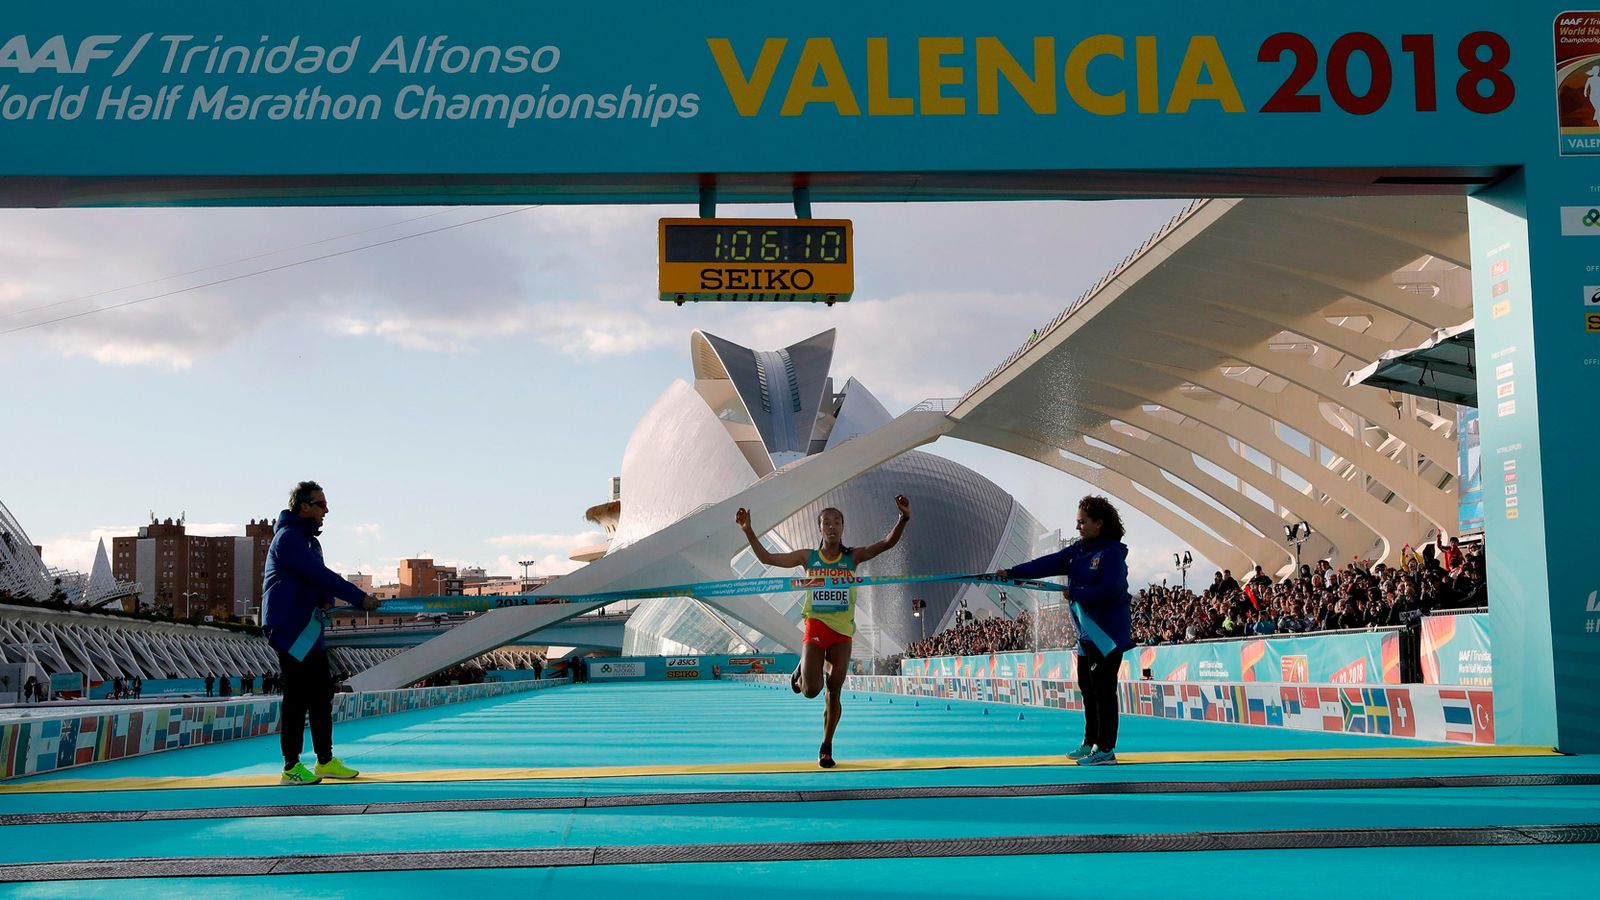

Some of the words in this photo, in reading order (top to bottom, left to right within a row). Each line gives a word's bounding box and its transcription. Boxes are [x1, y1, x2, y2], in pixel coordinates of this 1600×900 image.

[1560, 18, 1583, 26] IAAF
[1560, 26, 1587, 36] World
[1588, 26, 1600, 36] Ha
[160, 36, 361, 74] Trinidad
[370, 36, 560, 74] Alfonso
[707, 34, 1245, 116] VALENCIA
[1260, 31, 1514, 113] 2018
[96, 85, 183, 120] Half
[187, 86, 381, 120] Marathon
[395, 84, 699, 128] Championships
[714, 230, 840, 261] 1:06:10
[700, 268, 814, 291] SEIKO
[808, 568, 853, 578] ETHIOPIA
[813, 591, 848, 601] KEBEDE
[495, 598, 529, 608] 2018
[667, 670, 698, 678] SEIKO
